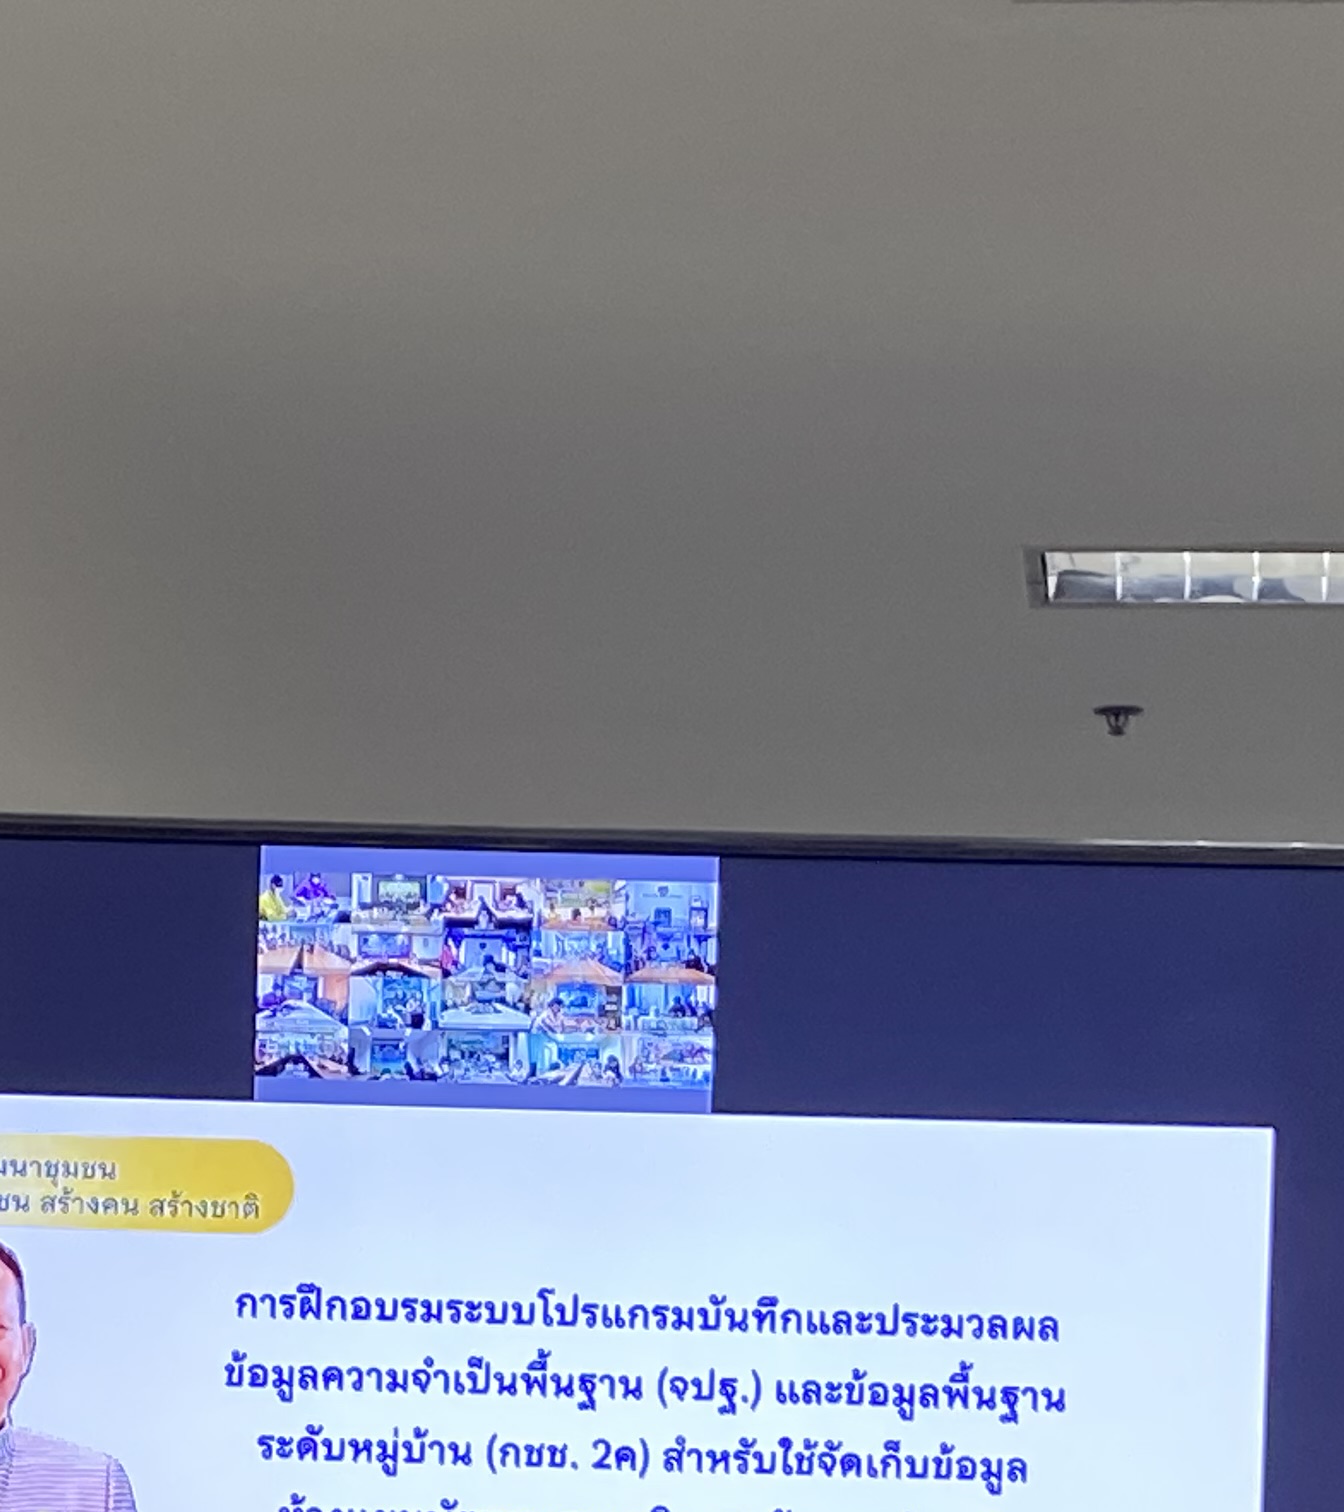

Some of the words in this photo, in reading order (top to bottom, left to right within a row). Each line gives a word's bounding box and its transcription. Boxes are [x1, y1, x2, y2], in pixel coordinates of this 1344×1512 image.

[40, 1186, 140, 1216] สร้างคน
[149, 1189, 260, 1220] สร้างชาติ
[257, 1423, 473, 1477] ระดับหมู่บ้าน
